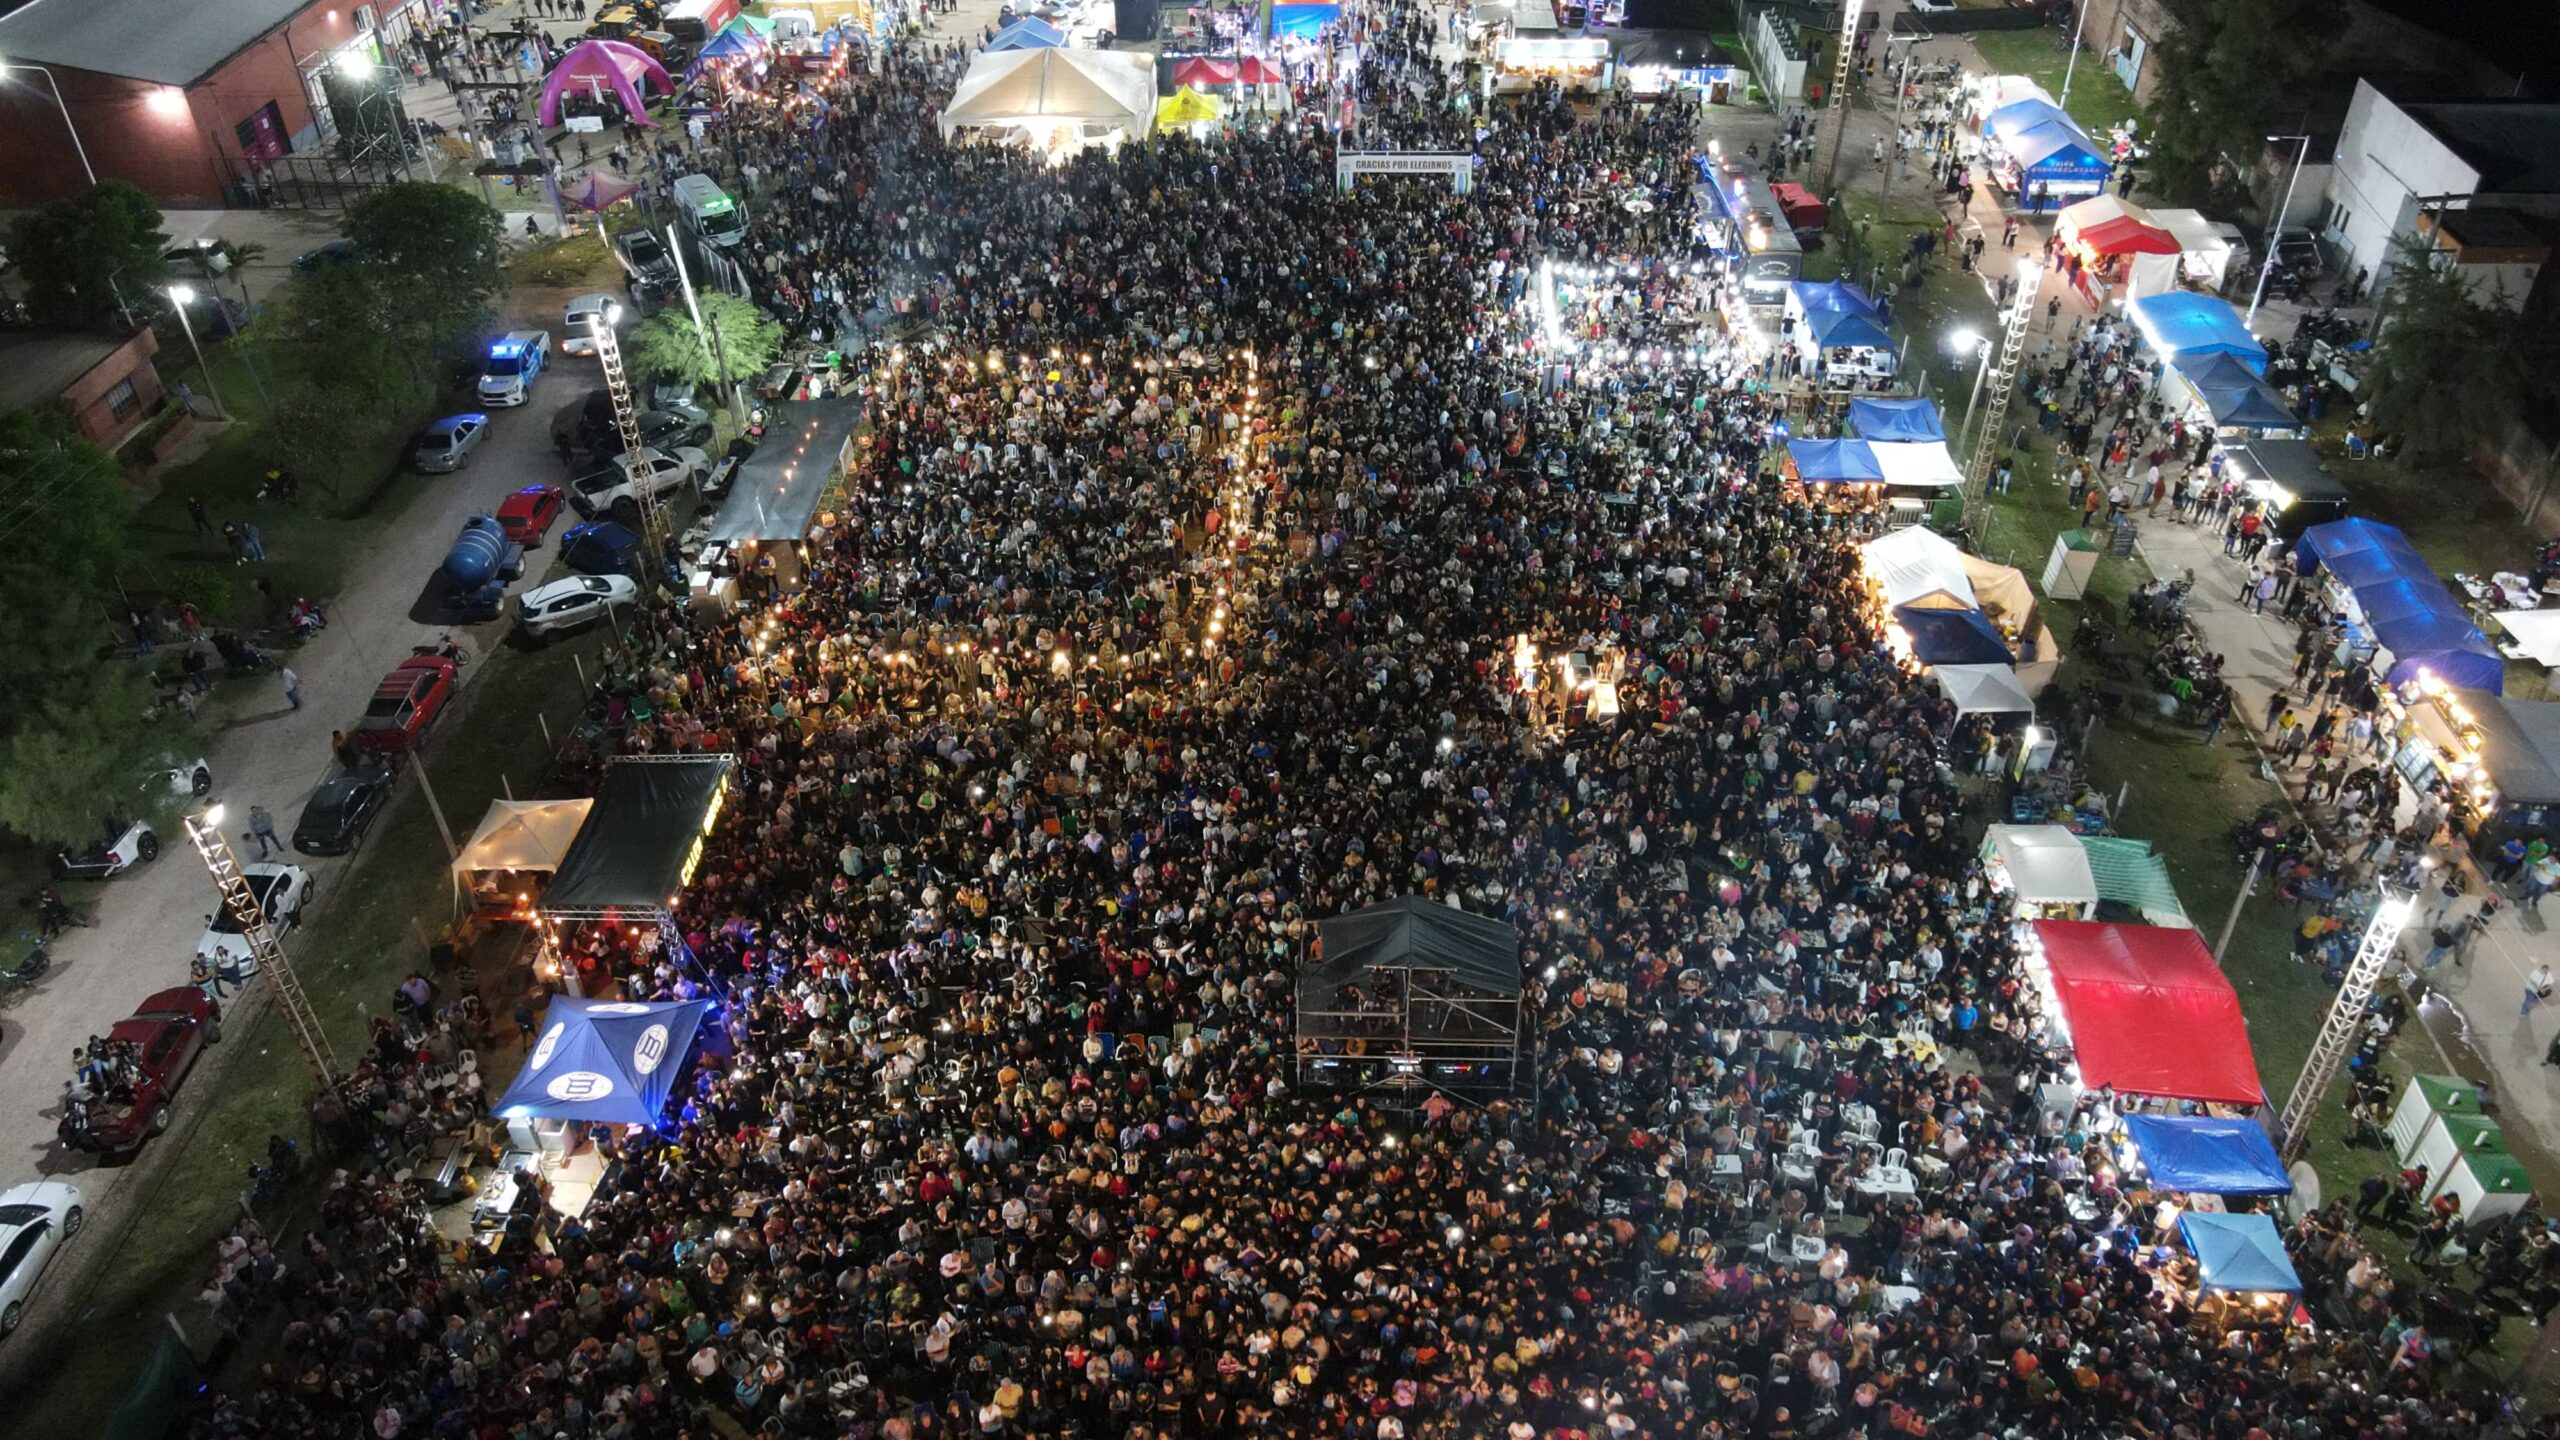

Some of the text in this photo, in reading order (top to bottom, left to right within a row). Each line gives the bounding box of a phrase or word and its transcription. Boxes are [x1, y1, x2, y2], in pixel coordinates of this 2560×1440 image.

[1355, 160, 1453, 170] GRACIAS POR ELEGIRNOS
